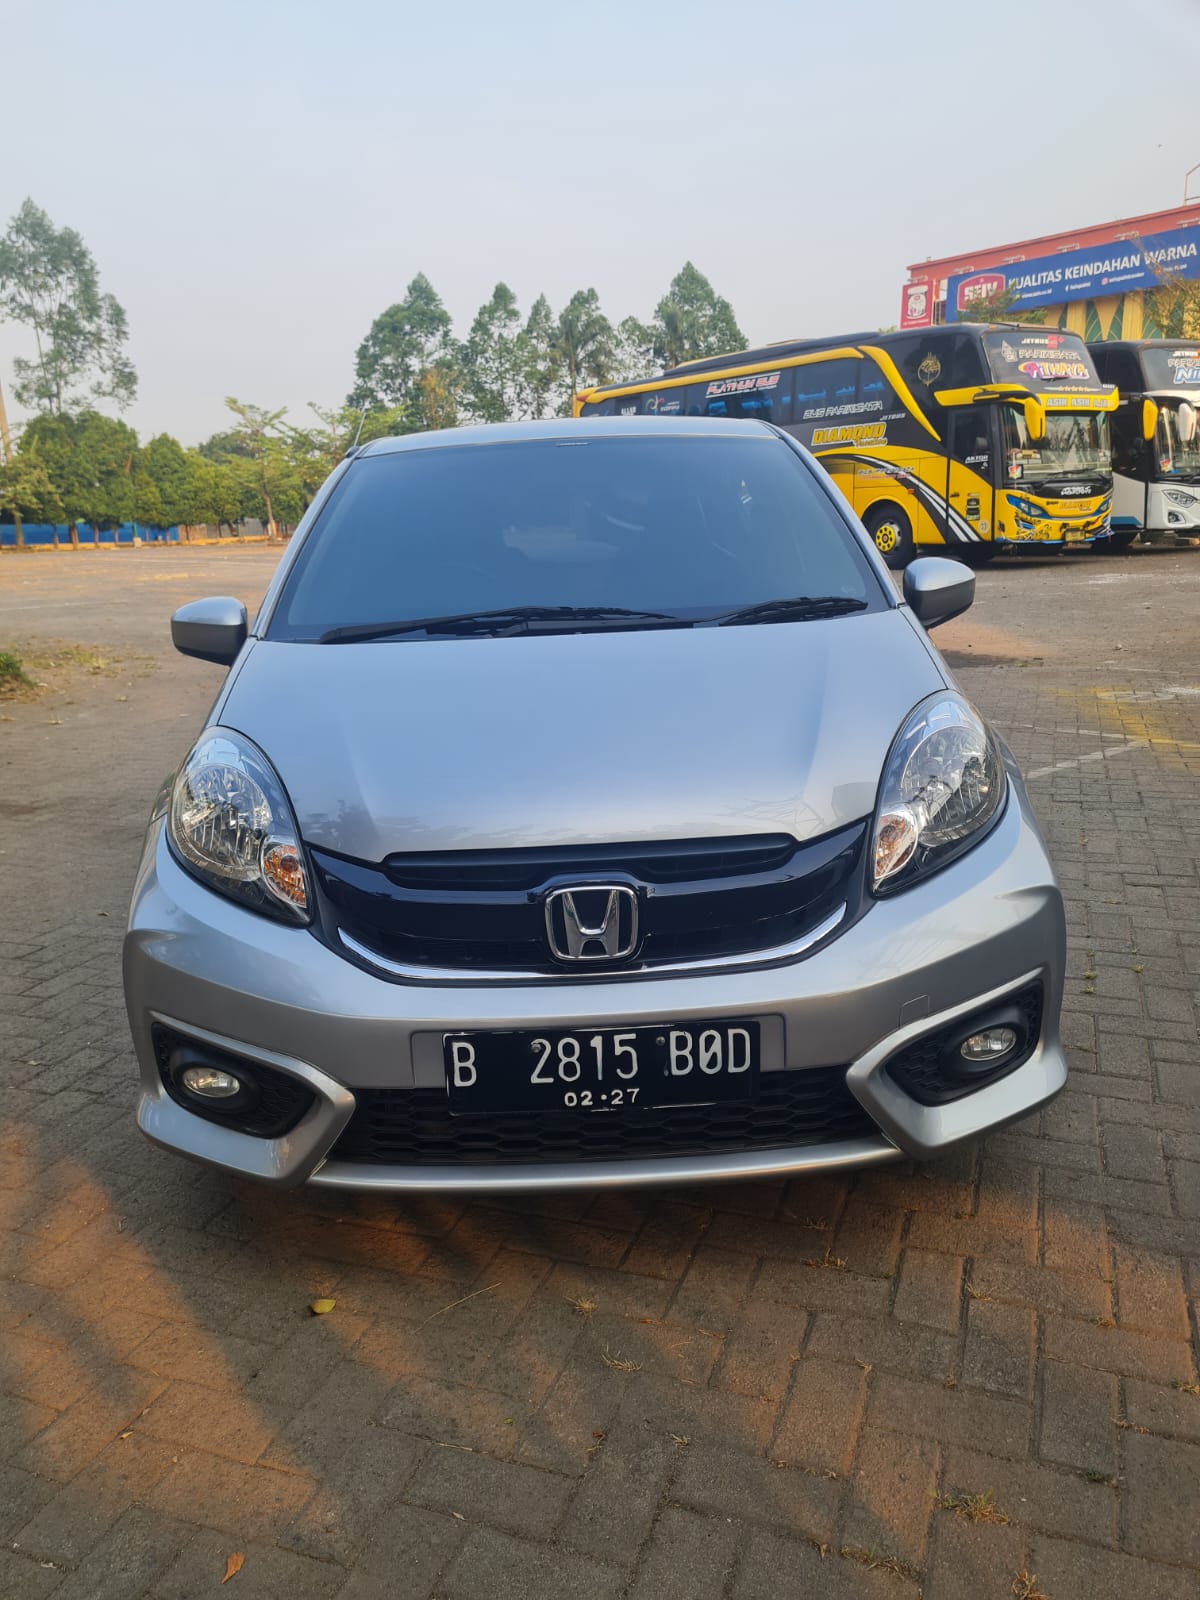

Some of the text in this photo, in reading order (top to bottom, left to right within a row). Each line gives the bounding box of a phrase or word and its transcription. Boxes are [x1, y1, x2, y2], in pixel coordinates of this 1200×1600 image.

[1008, 268, 1062, 291] KUALITAS
[1065, 253, 1141, 280] KEINDAHAN
[1144, 242, 1197, 265] WARNA
[1018, 349, 1082, 361] PARIWISATA
[803, 400, 883, 420] BUS PARIWISATA
[812, 422, 886, 445] DIAMOND
[452, 1042, 477, 1087] B
[530, 1033, 639, 1084] 2815
